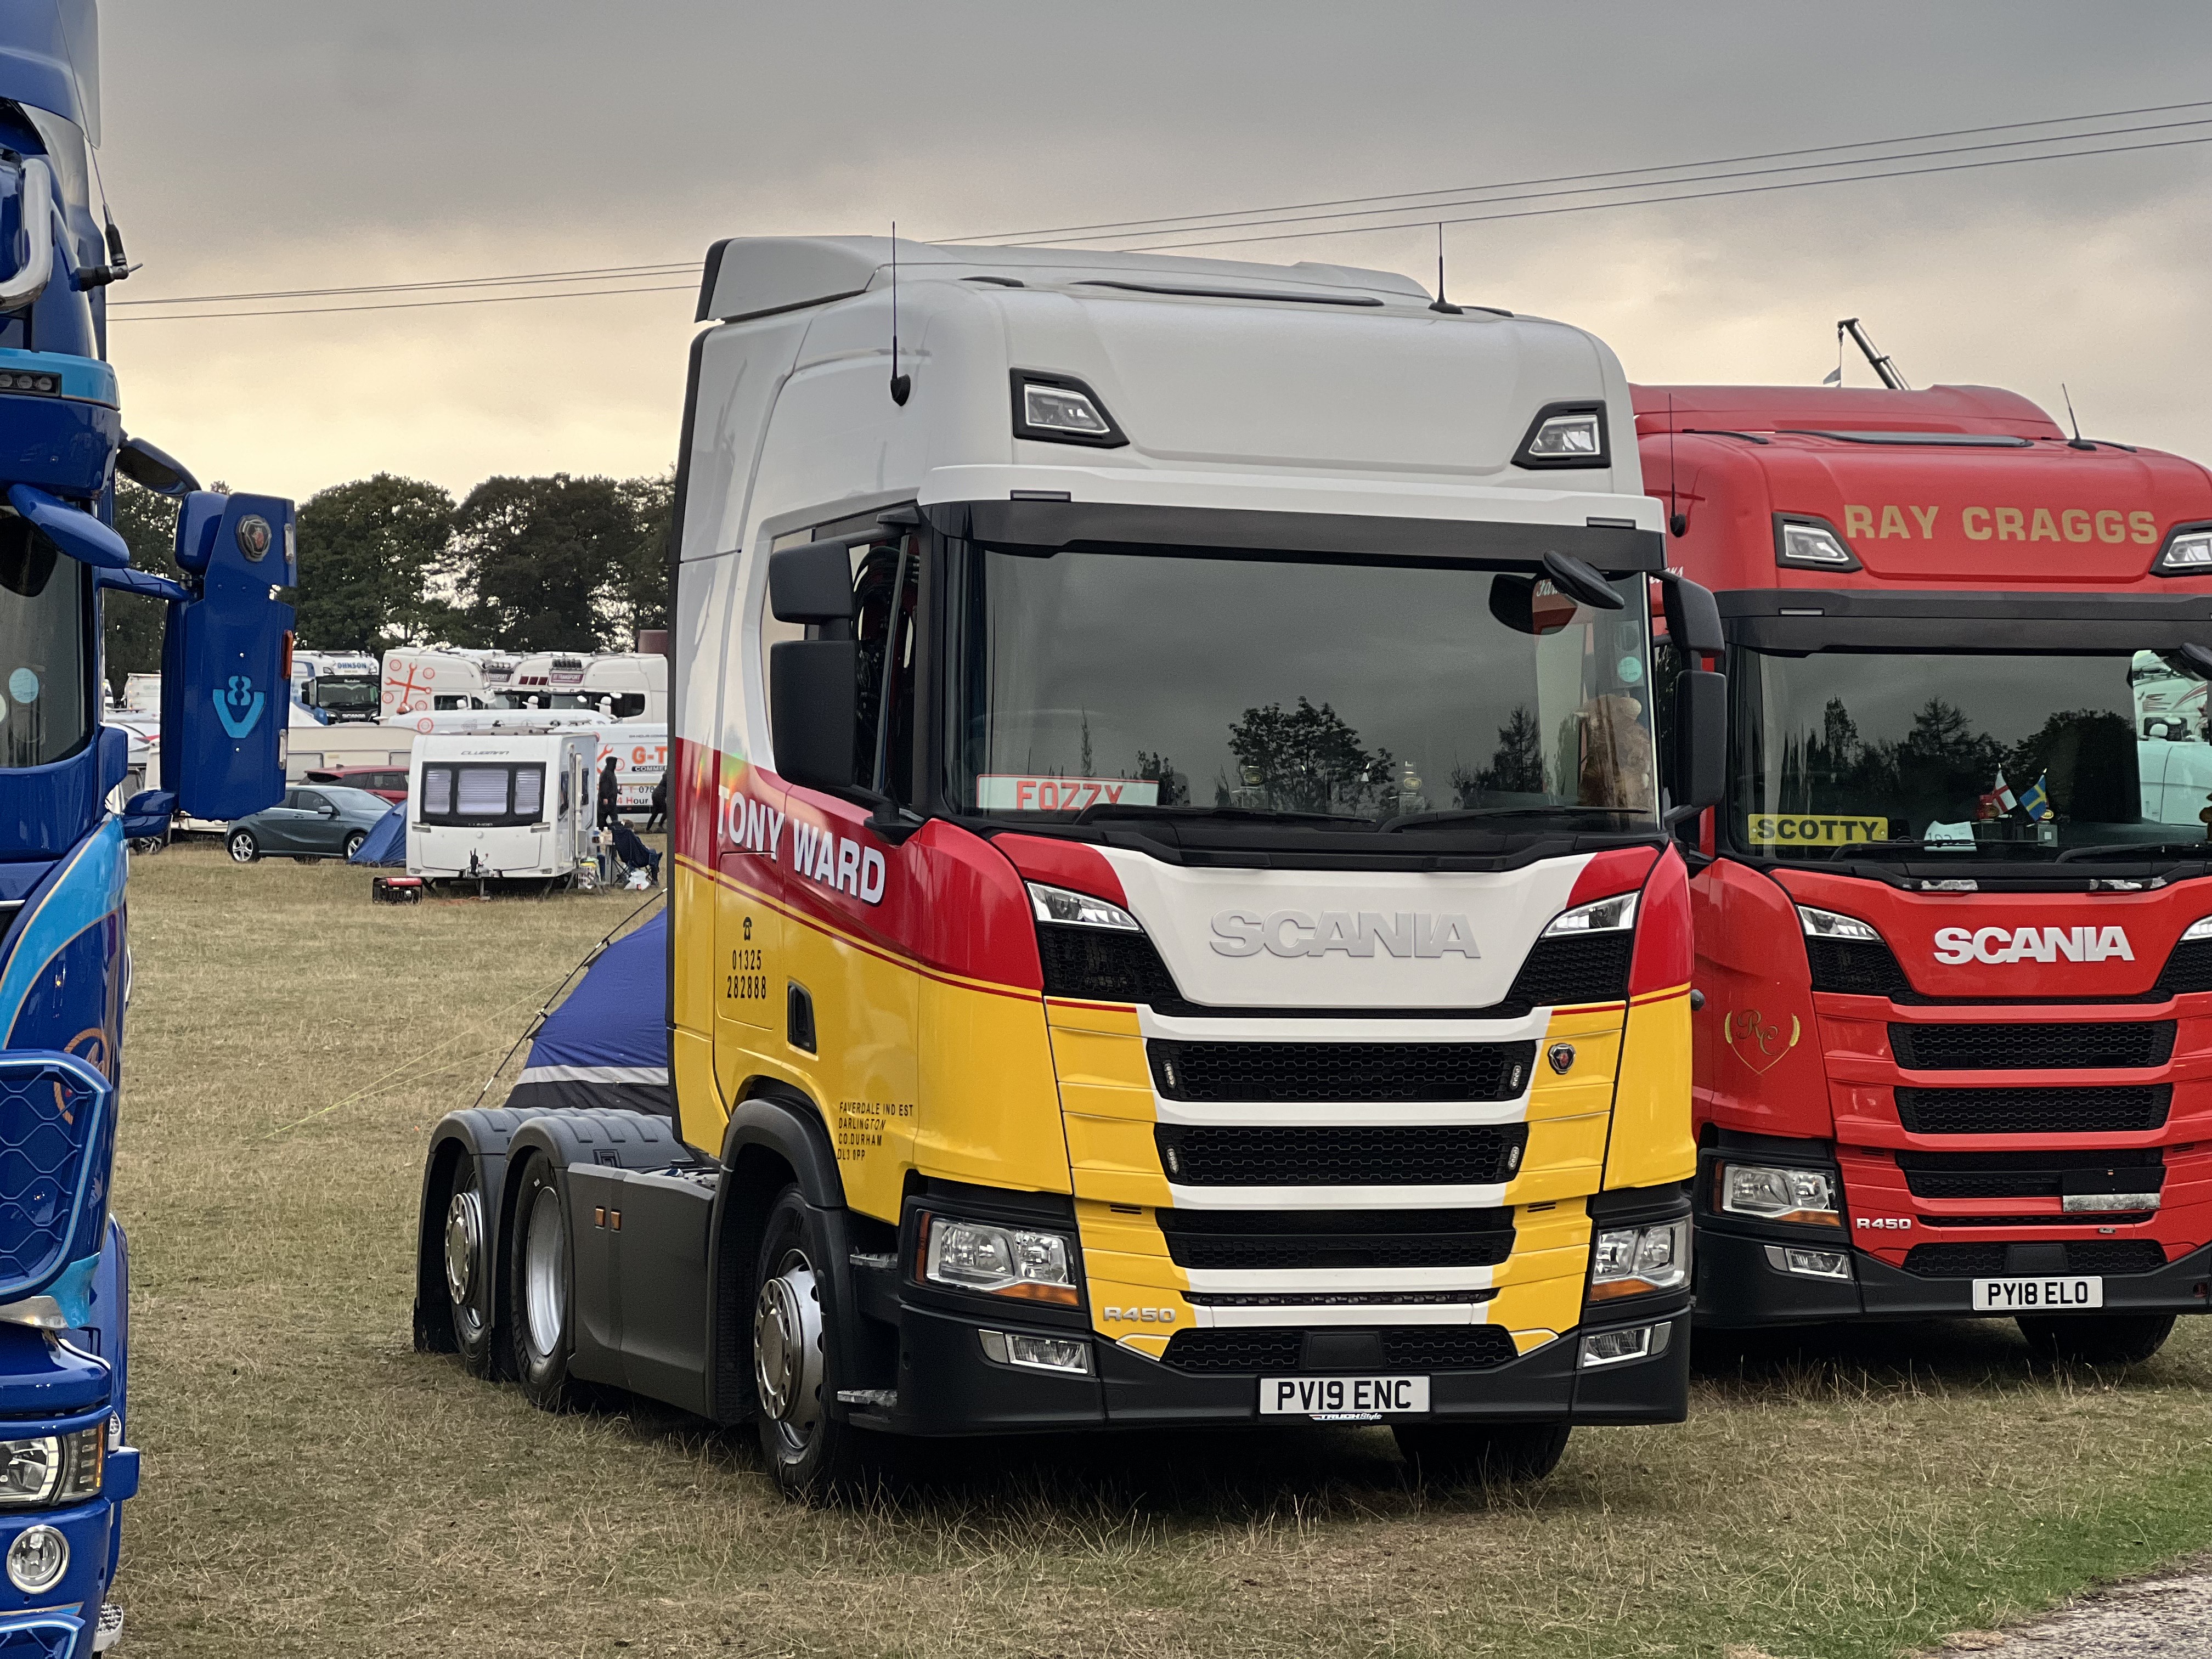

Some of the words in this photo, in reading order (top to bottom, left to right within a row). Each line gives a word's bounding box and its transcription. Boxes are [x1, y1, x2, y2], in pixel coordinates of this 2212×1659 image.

[1844, 505, 1939, 539] RAY
[1962, 506, 2158, 544] CRAGGS
[1016, 781, 1124, 810] FOZZY
[1757, 819, 1879, 841] SCOTTY
[718, 785, 785, 860] TONY
[793, 818, 886, 905] WARD
[1209, 909, 1481, 958] SCANIA
[1933, 926, 2135, 964] SCANIA
[732, 949, 761, 970] 01325
[727, 975, 766, 999] 282888
[839, 1102, 880, 1115] FAVERDALE
[883, 1104, 895, 1115] IND
[899, 1104, 913, 1116] EST
[838, 1118, 887, 1130] DARLINGTON
[837, 1149, 850, 1160] DL3
[1857, 1218, 1911, 1229] R450
[1988, 1283, 2038, 1306] PY18
[2045, 1281, 2088, 1304] ELO
[1104, 1307, 1176, 1322] R450
[1277, 1380, 1345, 1410] PV19
[1354, 1380, 1412, 1409] ENC
